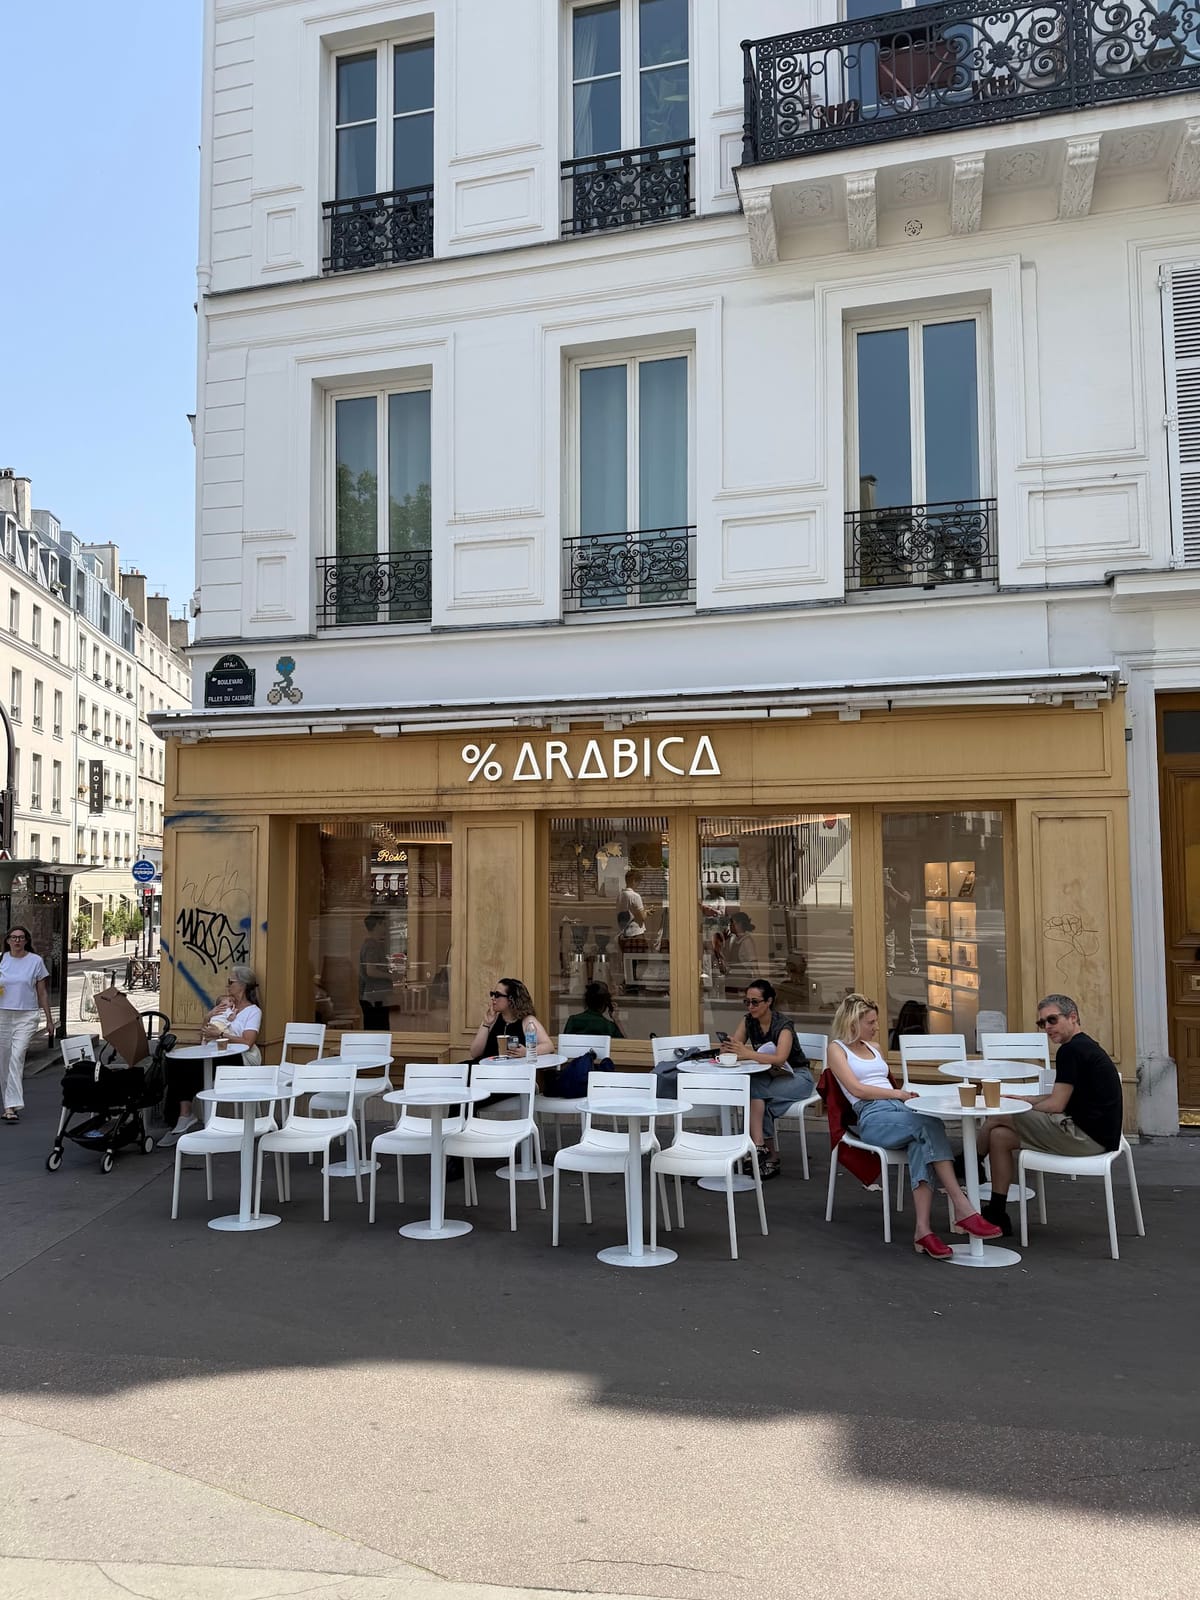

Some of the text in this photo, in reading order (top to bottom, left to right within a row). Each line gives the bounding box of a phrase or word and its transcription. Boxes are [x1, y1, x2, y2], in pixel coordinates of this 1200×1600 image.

[217, 678, 244, 686] BOULEVARD
[232, 694, 253, 702] CALVAIRE
[461, 735, 721, 782] % ARABICA
[377, 849, 408, 862] Resto
